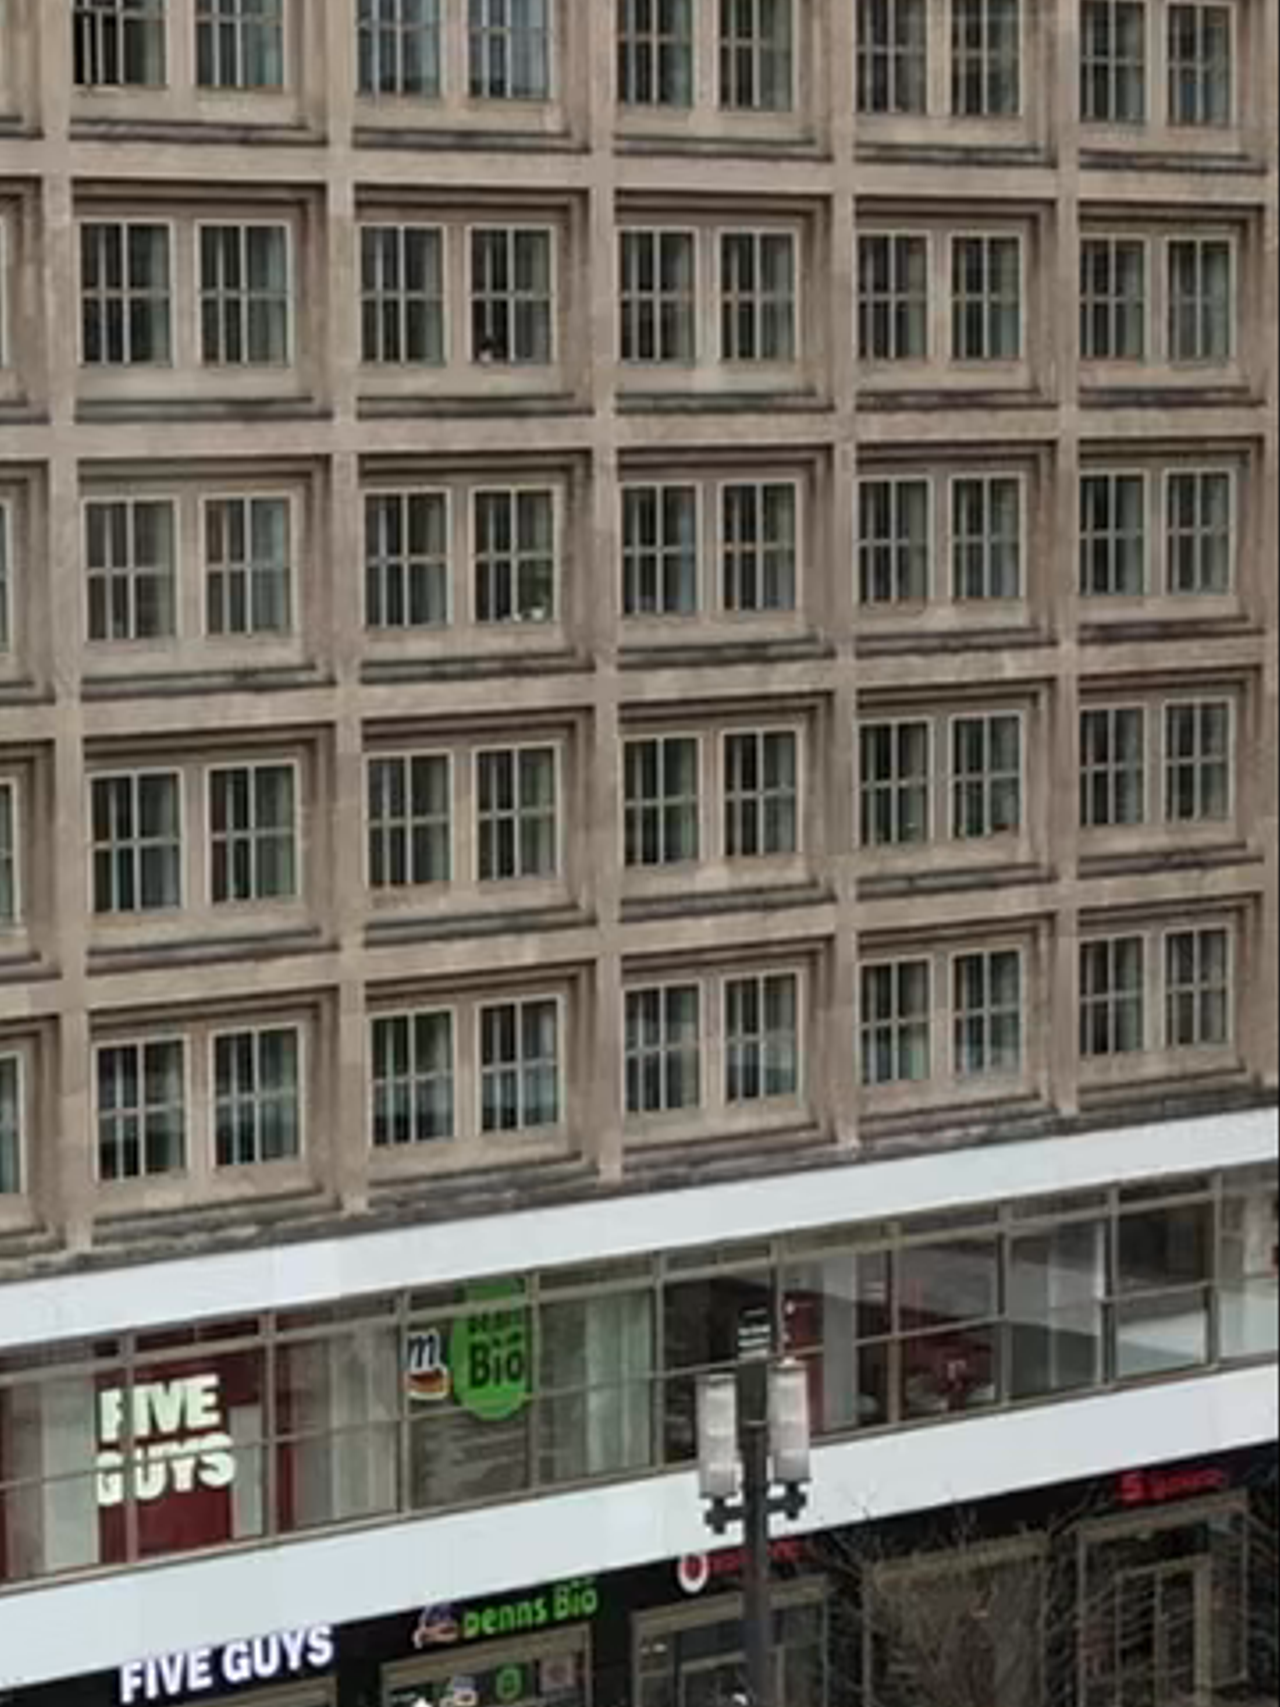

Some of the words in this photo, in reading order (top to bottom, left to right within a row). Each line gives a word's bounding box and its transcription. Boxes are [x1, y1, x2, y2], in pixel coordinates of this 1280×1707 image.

[101, 1374, 223, 1443] FIVE
[97, 1432, 236, 1507] GUYS
[120, 1646, 214, 1704] FIVE
[222, 1624, 334, 1684] GUYS
